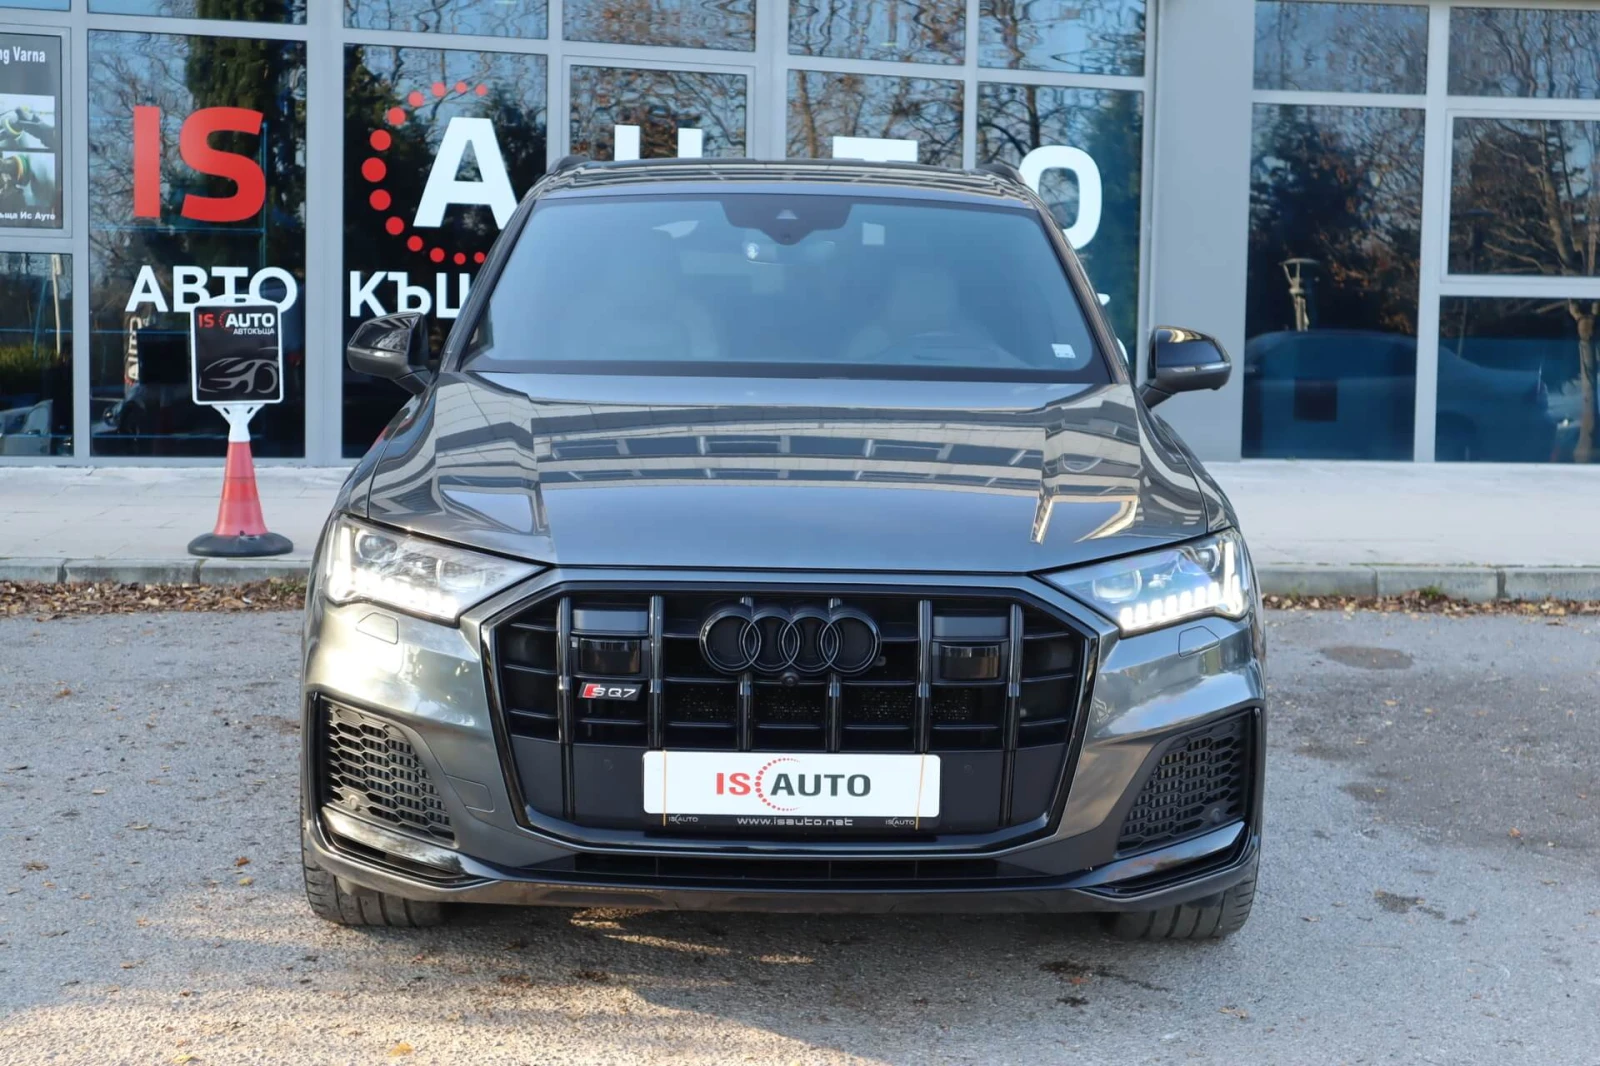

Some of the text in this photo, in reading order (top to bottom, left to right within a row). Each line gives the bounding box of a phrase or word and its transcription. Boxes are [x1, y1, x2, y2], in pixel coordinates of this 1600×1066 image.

[12, 45, 46, 63] Varna
[133, 105, 1102, 250] IS AO
[34, 211, 56, 222] Ауто
[125, 265, 298, 313] АВТО
[198, 312, 275, 328] IS AUTO
[233, 328, 275, 336] АВТОКЪЩА
[592, 687, 637, 698] SQ7
[715, 772, 871, 797] IS AUTO
[737, 816, 853, 827] www.isauto.net
